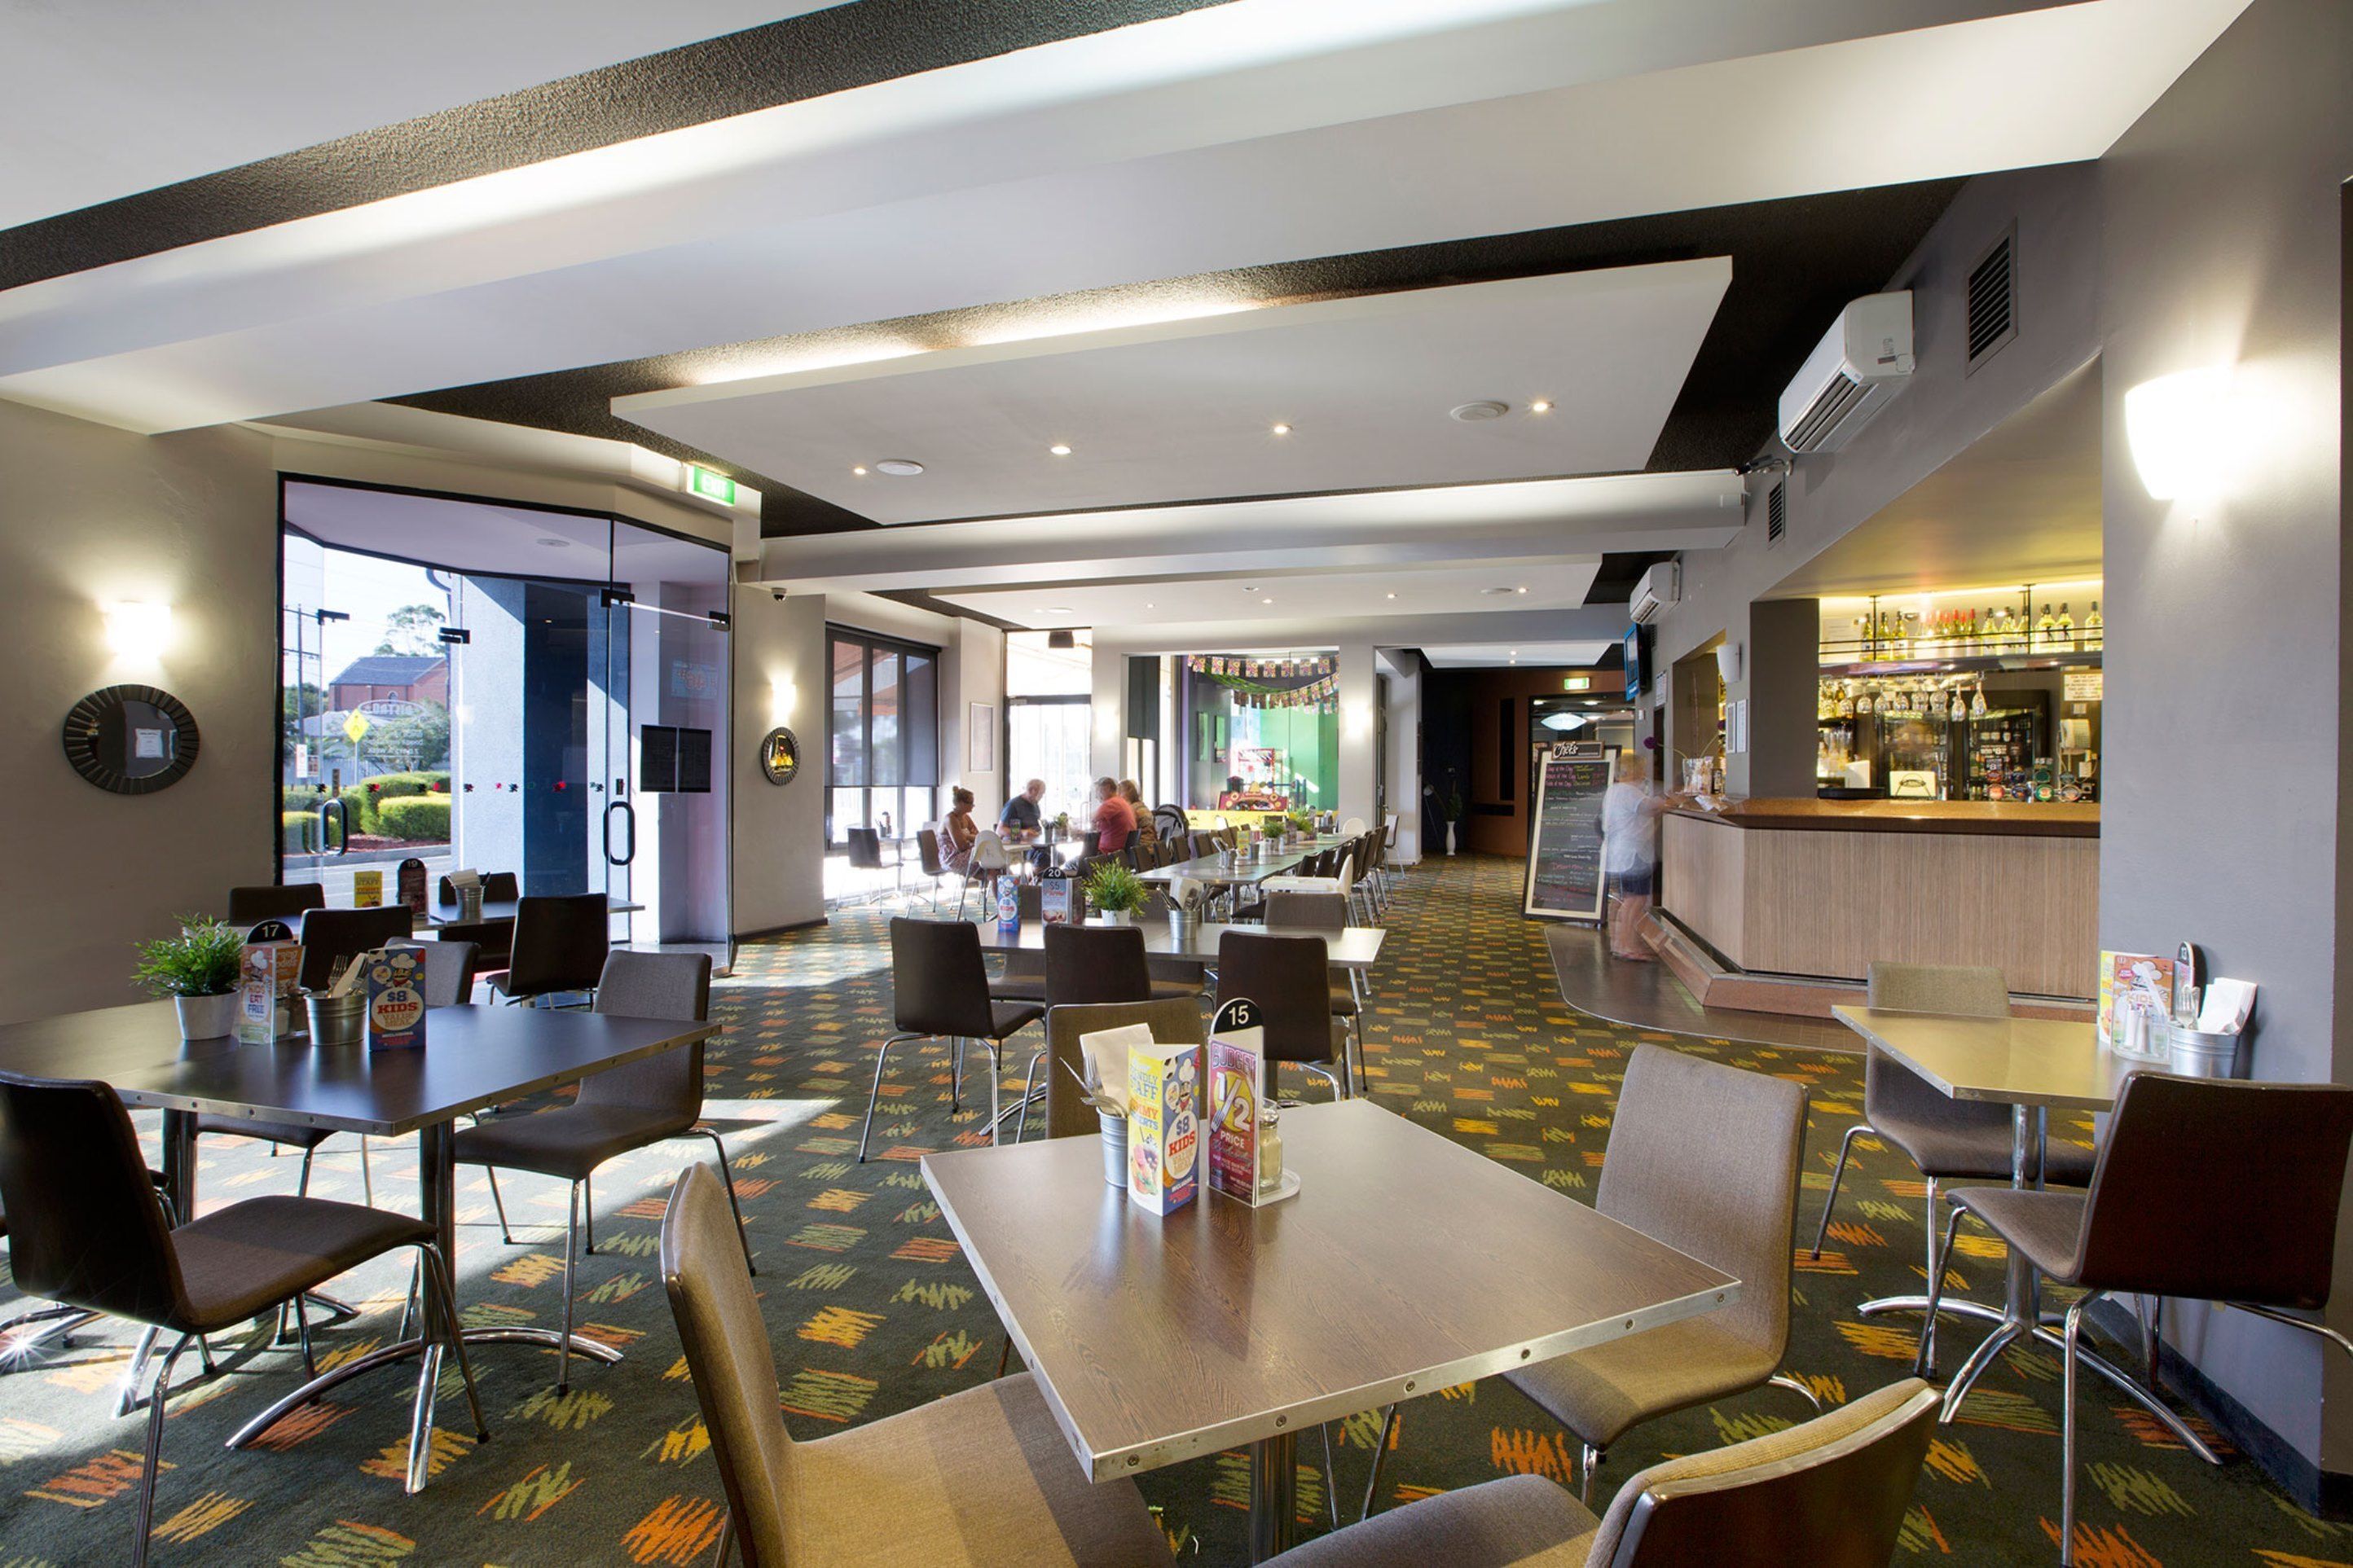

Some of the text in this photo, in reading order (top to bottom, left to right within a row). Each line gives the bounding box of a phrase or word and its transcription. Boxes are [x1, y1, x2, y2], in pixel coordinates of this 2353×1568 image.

[1049, 869, 1061, 877] 20
[262, 925, 279, 938] 17
[249, 995, 264, 1004] EAT
[387, 990, 407, 1002] $8
[248, 1004, 265, 1015] FREE
[377, 1002, 418, 1015] KIDS
[1229, 1005, 1250, 1026] 15
[1131, 1098, 1158, 1119] MMY
[1176, 1115, 1190, 1135] $8
[1168, 1130, 1195, 1157] KIDS
[1220, 1130, 1245, 1149] PRICE
